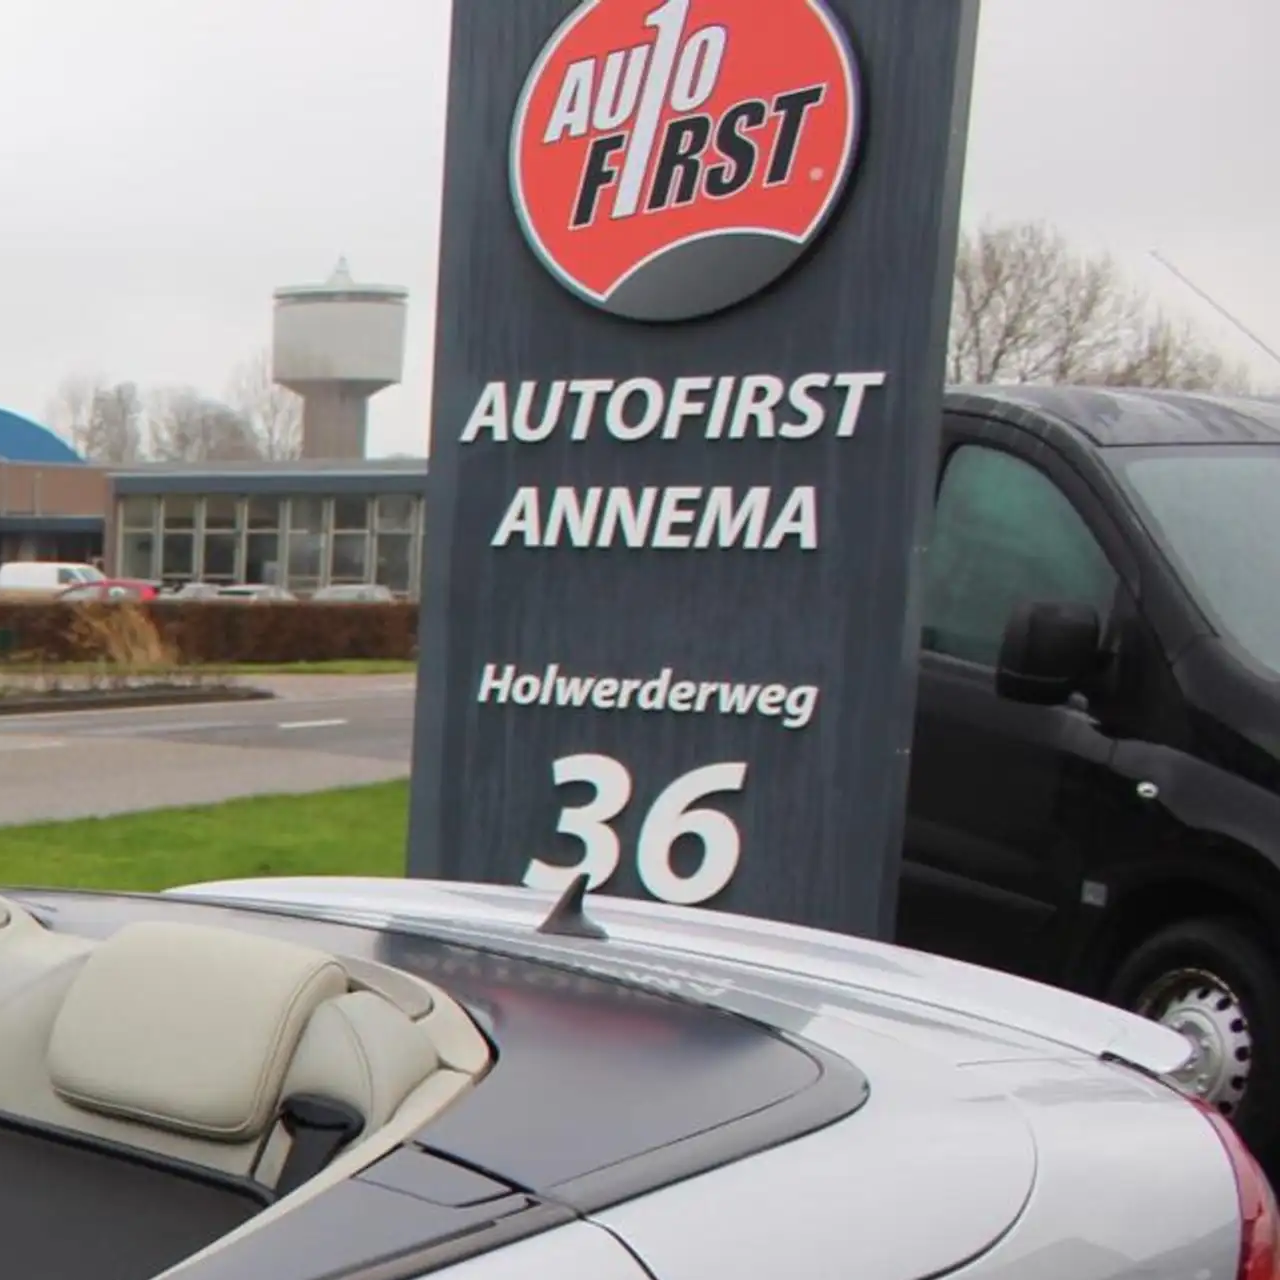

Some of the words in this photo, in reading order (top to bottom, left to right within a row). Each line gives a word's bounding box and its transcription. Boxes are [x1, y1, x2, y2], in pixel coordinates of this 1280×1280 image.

[459, 371, 886, 443] AUTOFIRST
[492, 485, 819, 550] ANNEMA
[477, 663, 819, 729] Holwerderweg
[522, 752, 748, 905] 36
